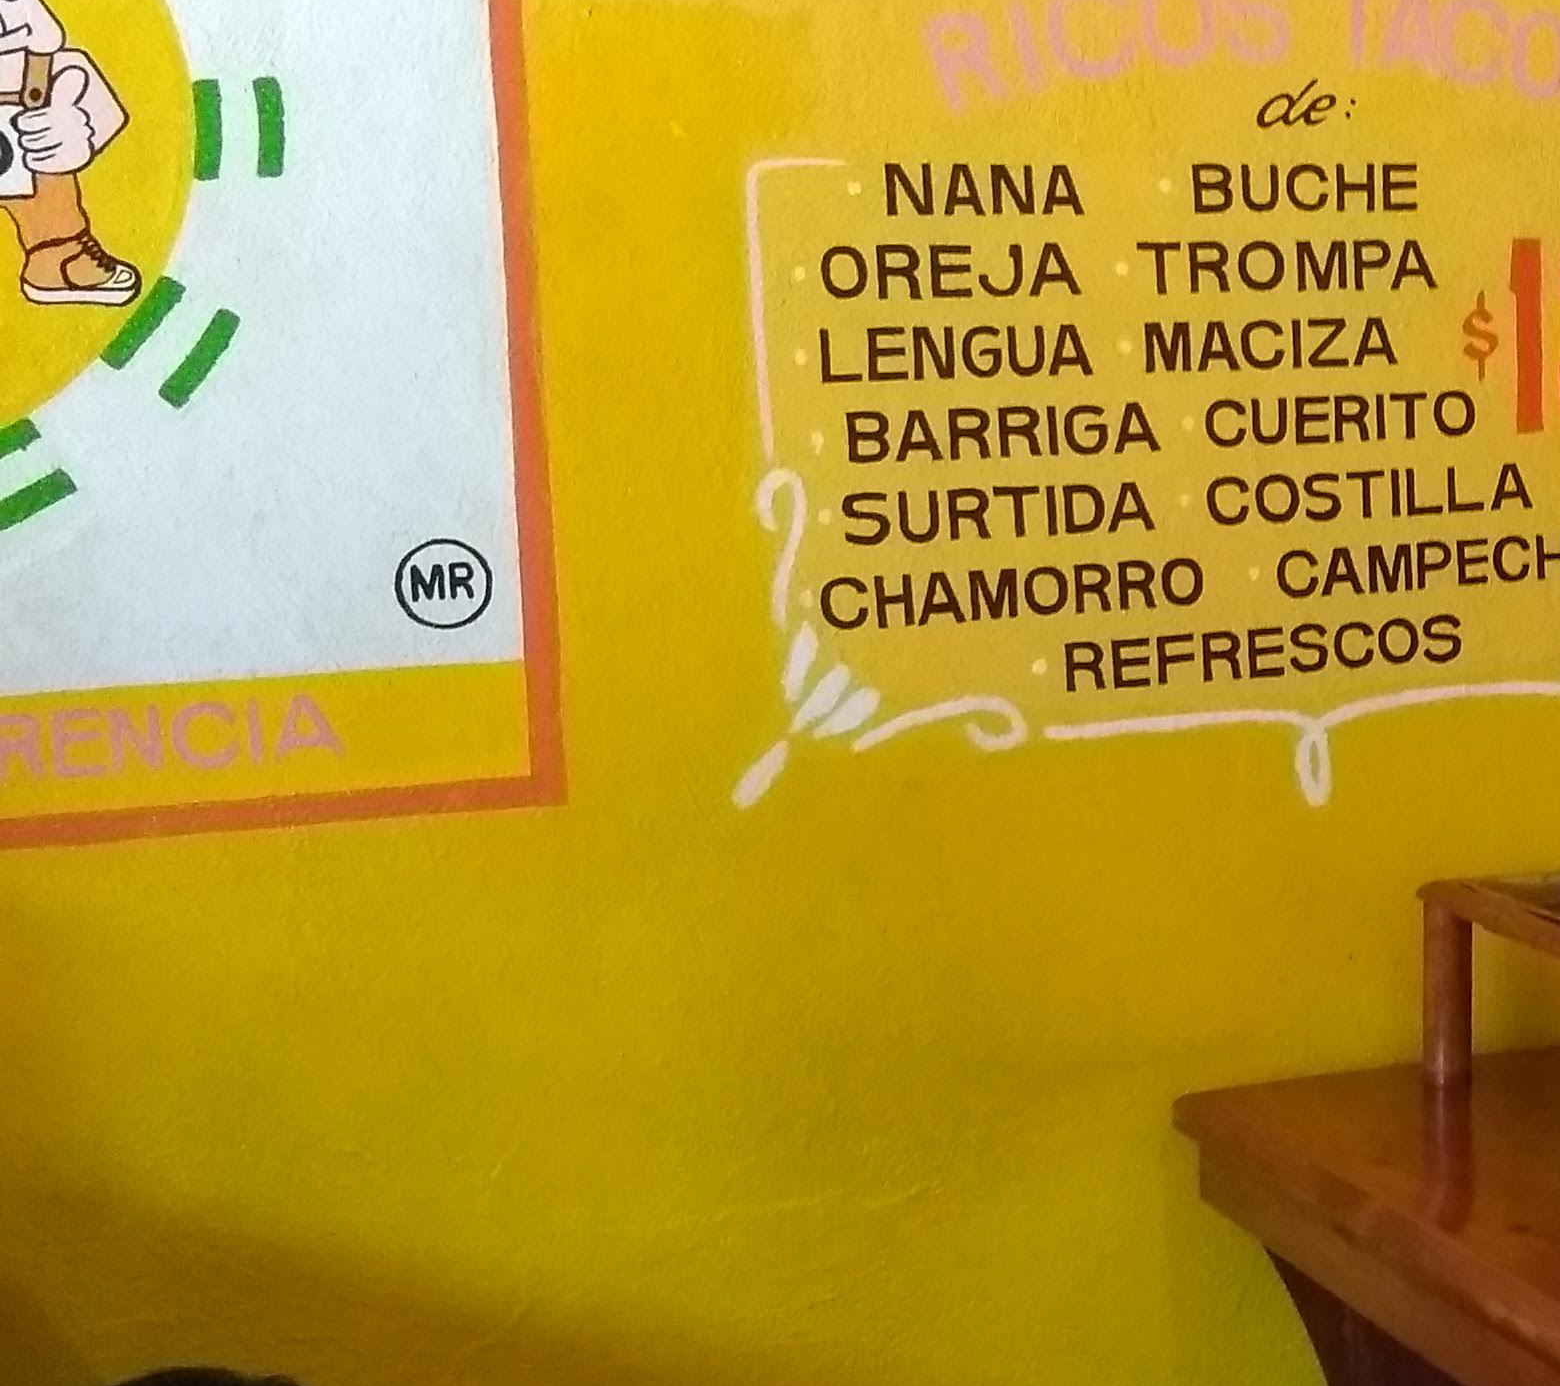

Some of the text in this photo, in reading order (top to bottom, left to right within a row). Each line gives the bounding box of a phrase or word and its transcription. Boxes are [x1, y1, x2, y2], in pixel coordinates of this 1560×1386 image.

[1256, 79, 1358, 130] de:
[884, 162, 1418, 217] NANA BUCHE
[820, 239, 1438, 300] OREJA TROMPA
[819, 317, 1399, 384] LENGUA MACIZA
[845, 390, 1476, 464] BARRIGA CUERITO
[841, 462, 1533, 546] SURTIDA COSTILLA
[410, 561, 475, 603] MR
[820, 557, 1204, 630] CHAMORRO
[1064, 613, 1462, 693] REFRESCOS
